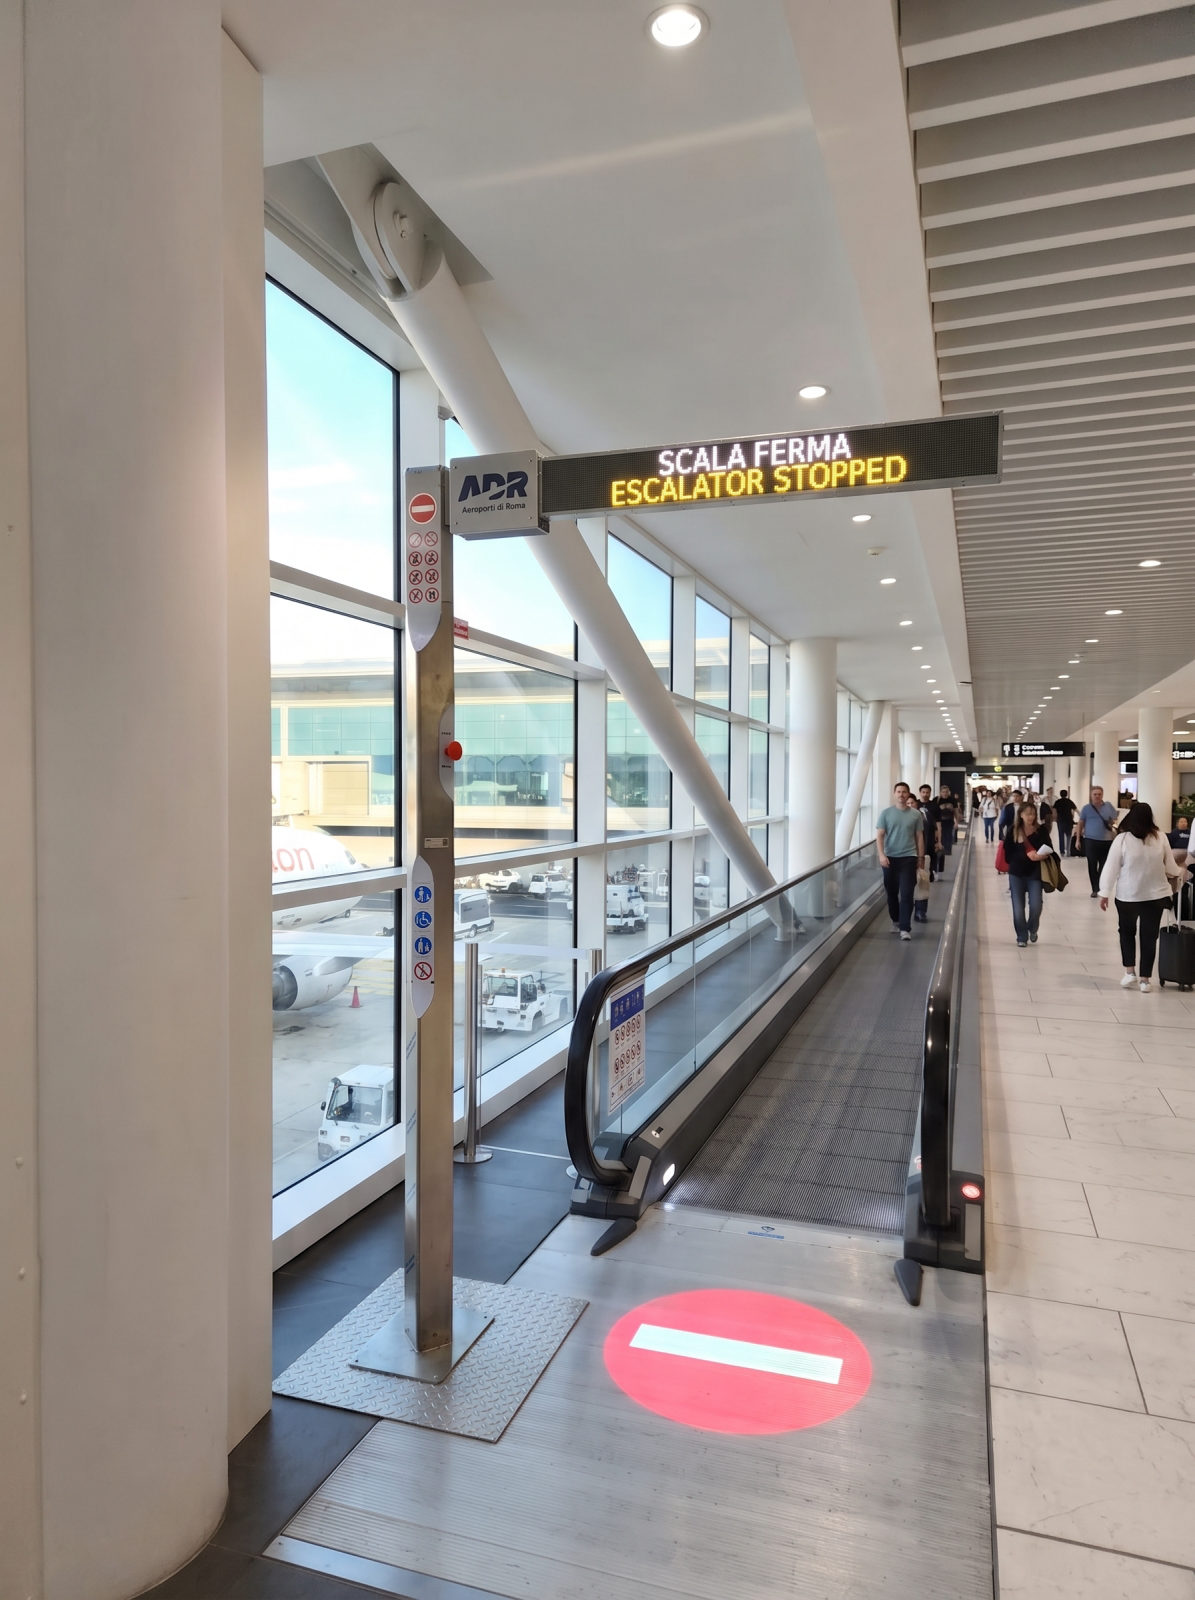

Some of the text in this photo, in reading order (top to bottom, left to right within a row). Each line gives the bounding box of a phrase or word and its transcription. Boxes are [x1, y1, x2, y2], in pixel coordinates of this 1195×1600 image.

[657, 433, 852, 476] SCALA FERMA
[458, 471, 528, 502] ADR
[611, 455, 907, 507] ESCALATOR STOPPED
[462, 504, 496, 514] Aeroporti
[497, 503, 504, 511] di
[272, 847, 315, 873] on
